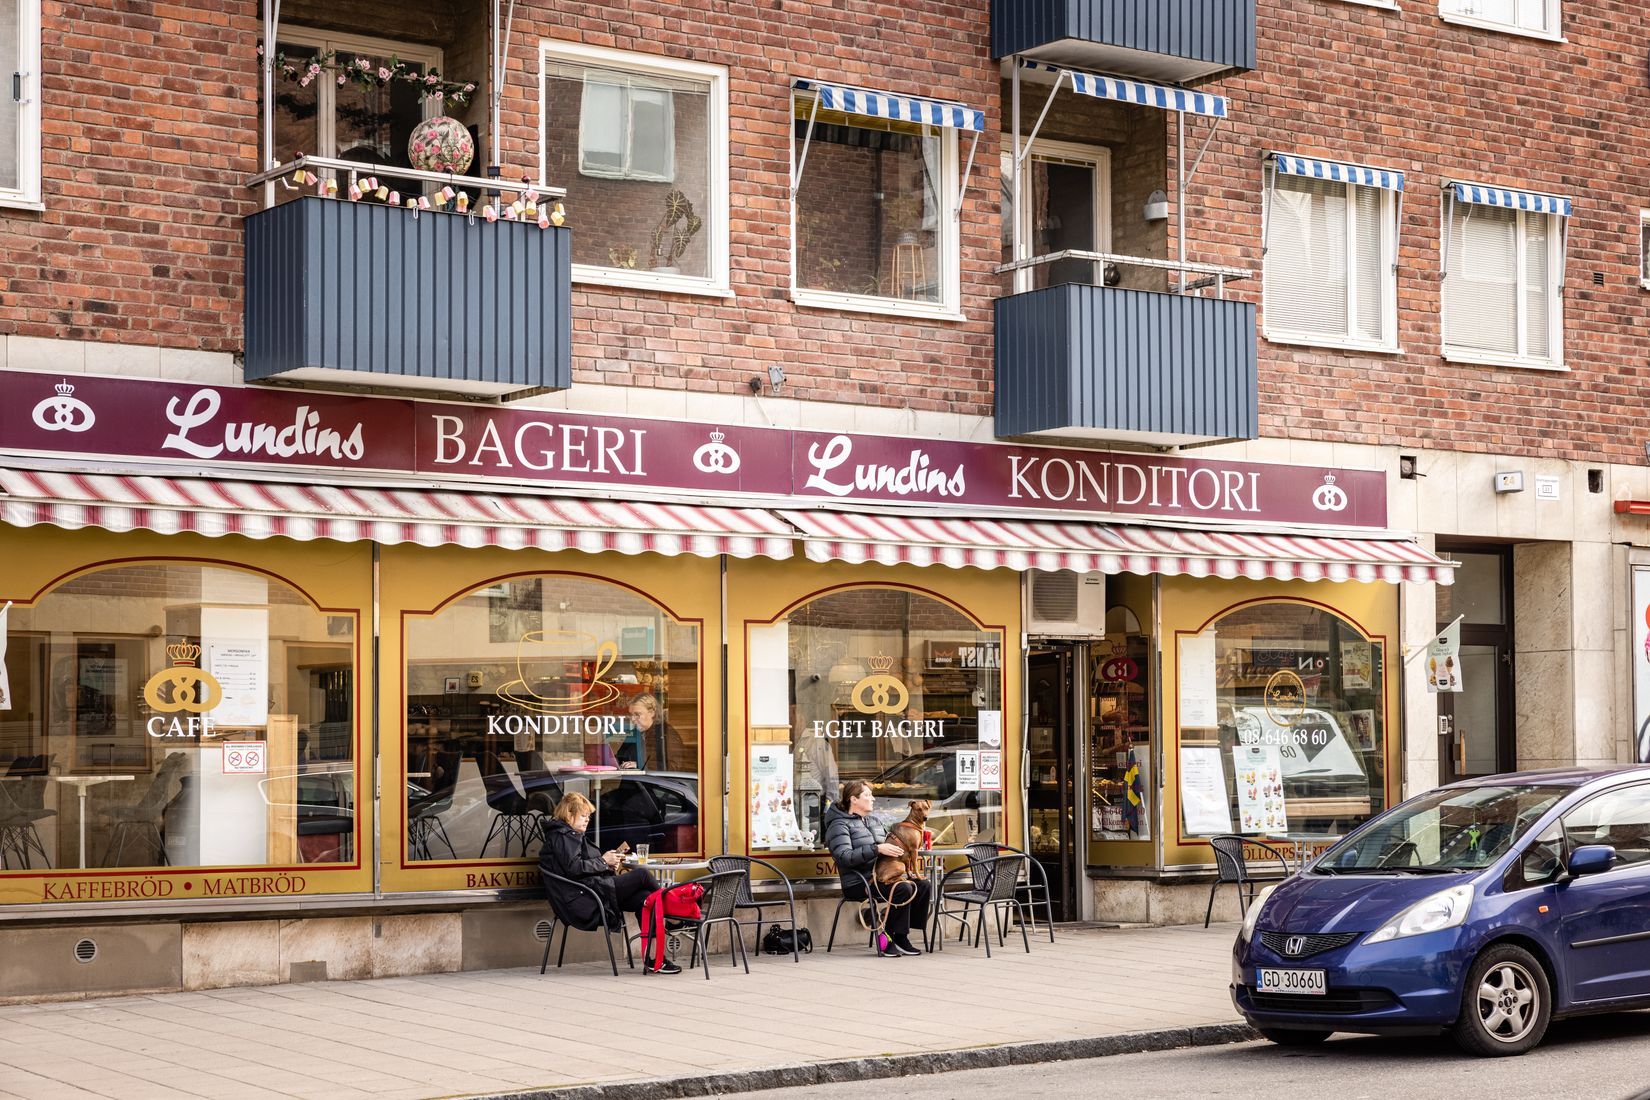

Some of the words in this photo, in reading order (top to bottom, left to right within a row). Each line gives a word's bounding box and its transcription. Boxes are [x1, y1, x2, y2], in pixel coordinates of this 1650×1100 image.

[162, 388, 364, 460] Lundins
[432, 415, 647, 476] BAGERI
[804, 434, 965, 496] Lundins
[1007, 455, 1261, 512] KONDITORI
[147, 717, 217, 738] CAFE
[487, 715, 626, 735] KONDITORI
[813, 720, 866, 738] EGET
[871, 720, 945, 738] BAGERI
[1244, 728, 1289, 745] 08-646
[1292, 728, 1308, 745] 68
[1311, 728, 1327, 745] 60
[43, 876, 173, 900] KAFFEBRÖD
[203, 872, 306, 896] MATBRÖD
[1263, 971, 1280, 987] GD
[1284, 972, 1323, 988] 3066U
